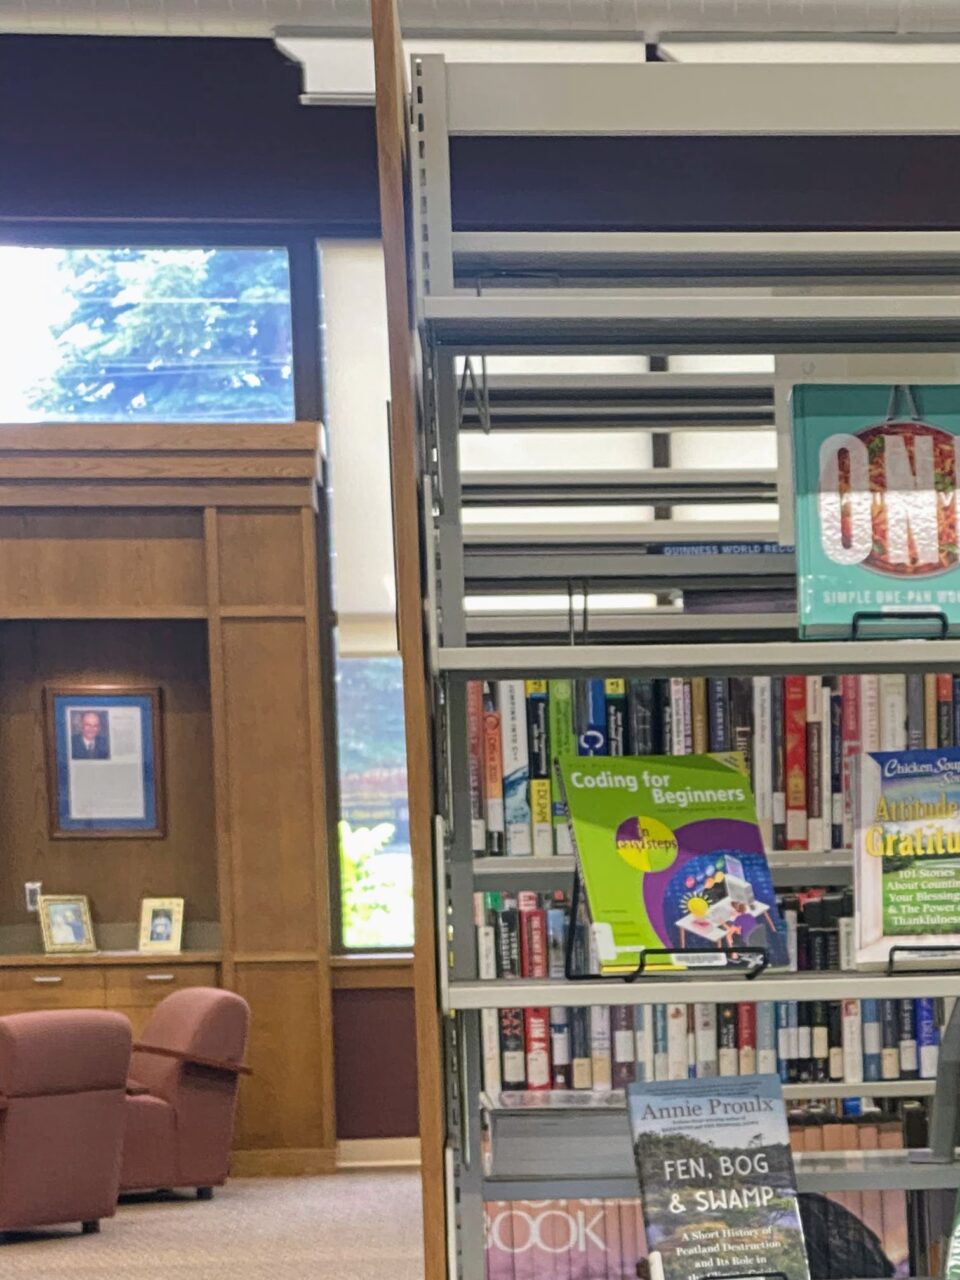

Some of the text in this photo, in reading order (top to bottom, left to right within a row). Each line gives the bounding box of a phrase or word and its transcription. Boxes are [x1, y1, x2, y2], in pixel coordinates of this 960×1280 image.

[664, 545, 719, 556] GUINNESS
[721, 544, 762, 553] WORLD
[824, 591, 872, 604] SIMPLE
[876, 591, 933, 603] ONE-PAN
[885, 758, 935, 777] Chicken
[571, 771, 671, 792] Coding for
[652, 786, 746, 808] Beginners
[875, 793, 958, 823] Attitude
[617, 838, 677, 854] easy steps
[899, 869, 956, 879] 101 Stories
[886, 880, 918, 891] About
[888, 893, 914, 903] Your
[887, 906, 898, 914] &
[901, 904, 920, 914] The
[922, 903, 956, 913] Power
[642, 1100, 703, 1122] Annie
[710, 1094, 775, 1116] Proulx
[664, 1152, 770, 1181] FEN, BOG
[669, 1193, 687, 1214] &
[697, 1185, 775, 1211] SWAMP
[681, 1225, 774, 1242] A Short History of
[676, 1240, 782, 1256] Peatland Destruction
[694, 1254, 768, 1268] and Its Role in
